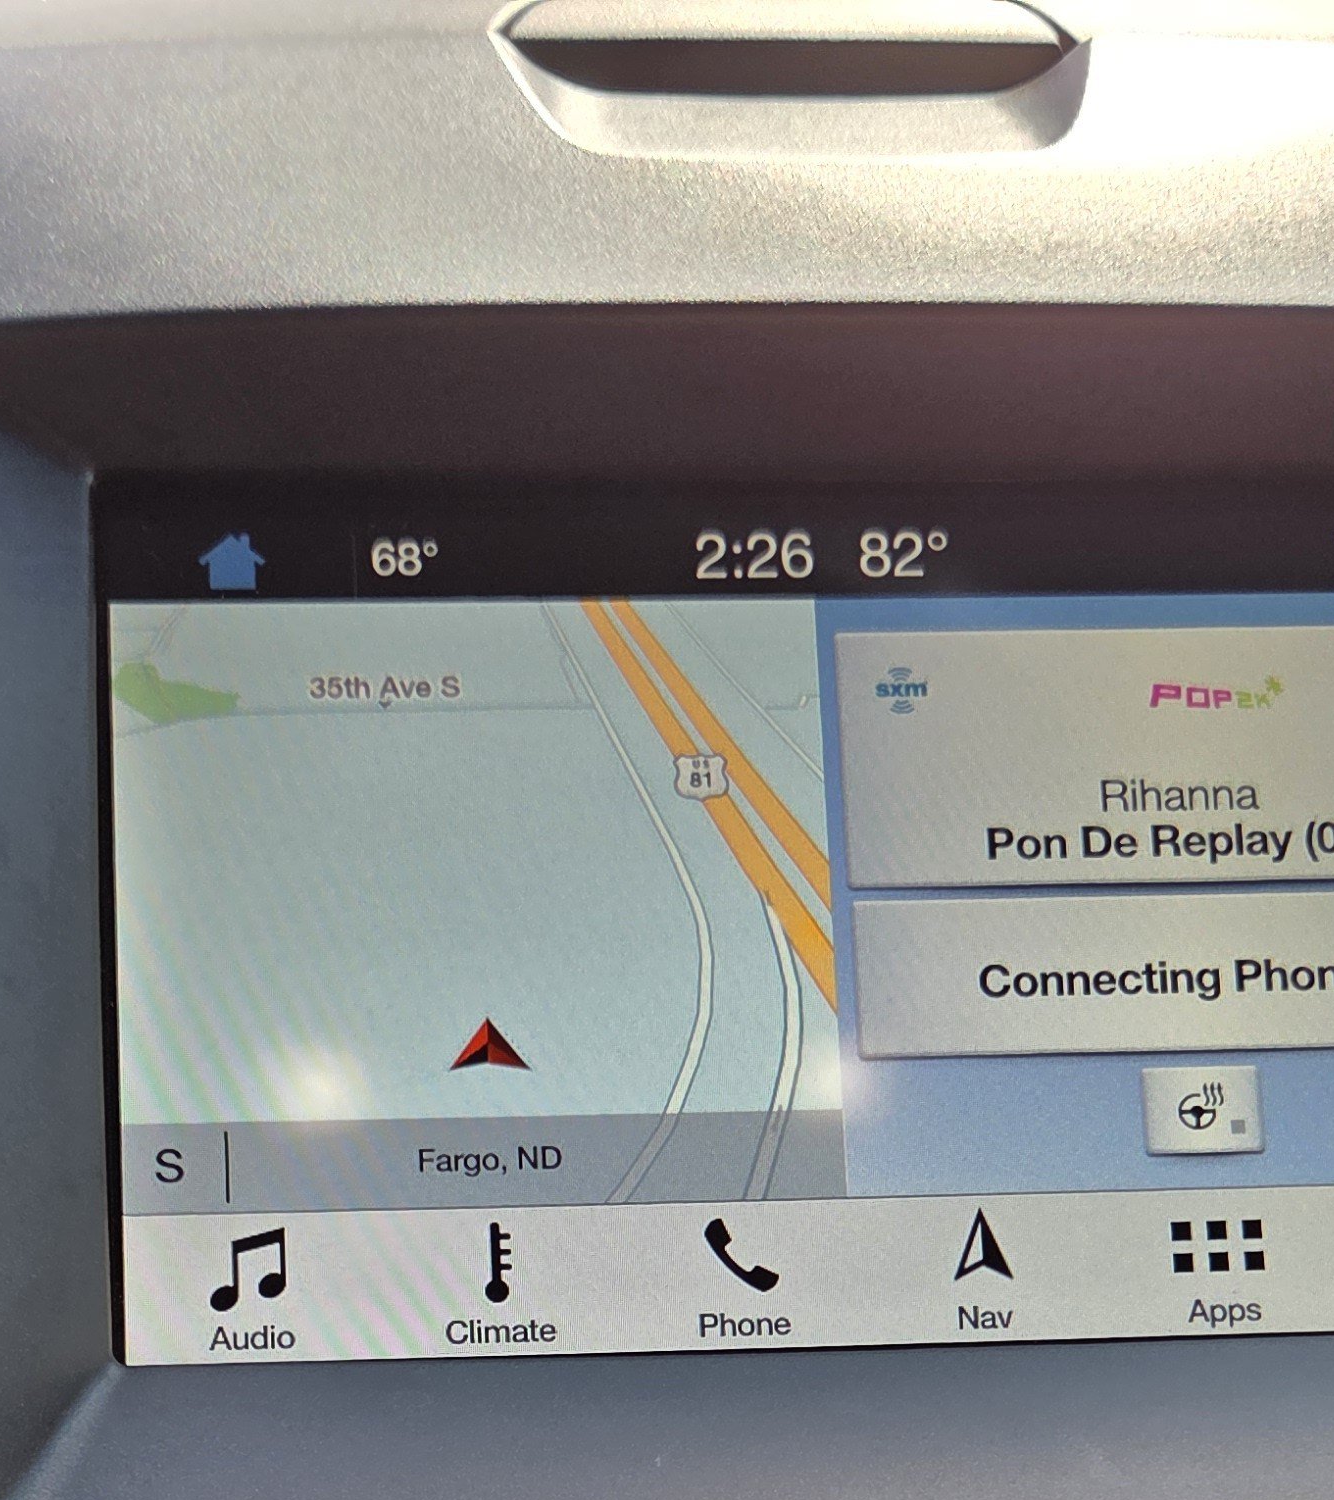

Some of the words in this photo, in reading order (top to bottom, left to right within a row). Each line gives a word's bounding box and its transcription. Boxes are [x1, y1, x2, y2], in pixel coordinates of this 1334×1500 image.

[370, 537, 439, 577] 68°
[695, 529, 815, 580] 2:26
[858, 529, 949, 579] 82°
[309, 675, 372, 700] 35th
[378, 675, 435, 700] Ave
[441, 674, 462, 699] S
[875, 680, 928, 698] sxm
[690, 772, 711, 788] 81
[1100, 779, 1261, 812] Rihanna
[986, 826, 1068, 860] Pon
[1081, 825, 1139, 858] De
[1150, 823, 1293, 864] Replay
[978, 960, 1221, 1001] Connecting
[154, 1147, 185, 1184] S
[418, 1147, 509, 1178] Fargo,
[518, 1146, 563, 1171] ND
[698, 1311, 793, 1338] Phone
[957, 1305, 1014, 1330] Nav
[1187, 1299, 1263, 1328] Apps
[209, 1323, 297, 1352] Audio
[445, 1316, 558, 1346] Climate
